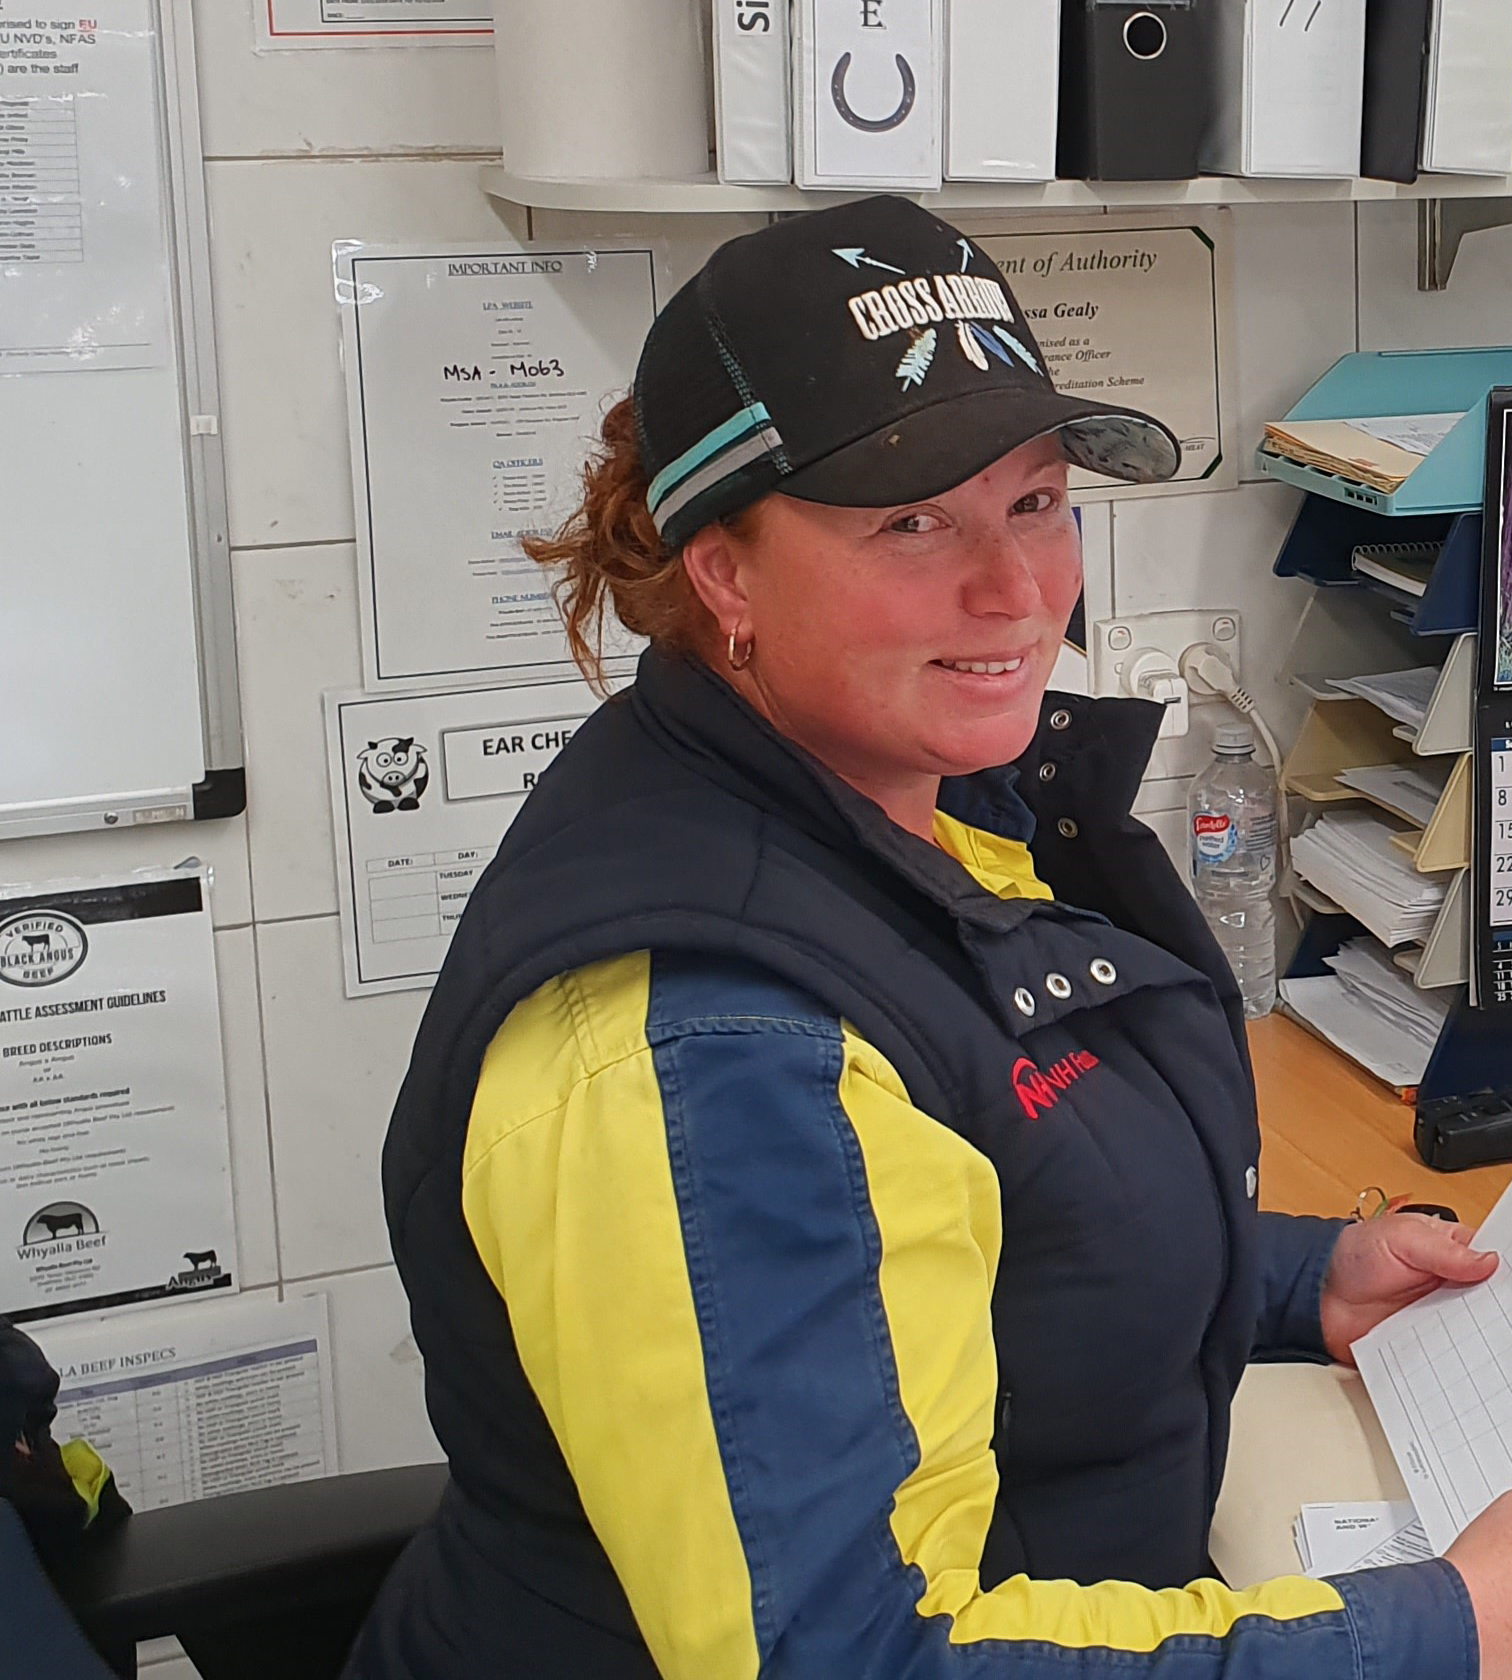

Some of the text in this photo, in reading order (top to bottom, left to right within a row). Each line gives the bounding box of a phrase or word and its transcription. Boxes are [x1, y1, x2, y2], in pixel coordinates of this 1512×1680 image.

[60, 33, 97, 45] NFAS
[31, 63, 50, 74] the
[448, 259, 563, 277] IMPORTANT INFO
[1033, 251, 1058, 278] of
[1059, 248, 1158, 272] Authority
[847, 276, 945, 341] CROSS
[1053, 301, 1099, 320] Gealy
[1068, 337, 1082, 347] as
[1075, 349, 1112, 363] Officer
[443, 364, 483, 381] MSA
[1106, 376, 1145, 388] Scheme
[482, 735, 525, 756] EAR
[1498, 755, 1505, 773] 1
[1498, 789, 1508, 806] 8
[387, 851, 479, 868] DATE: DAY:
[439, 869, 474, 880] TUESDAY
[5, 920, 64, 939] VERIFIED
[34, 997, 105, 1019] ASSESSMENT
[106, 989, 167, 1009] GUIDELINES
[2, 1032, 113, 1059] BREED DESCRIPTIONS
[17, 1234, 107, 1261] Whyalla Beef
[80, 1357, 117, 1376] BEEF
[119, 1347, 178, 1369] INSPECS
